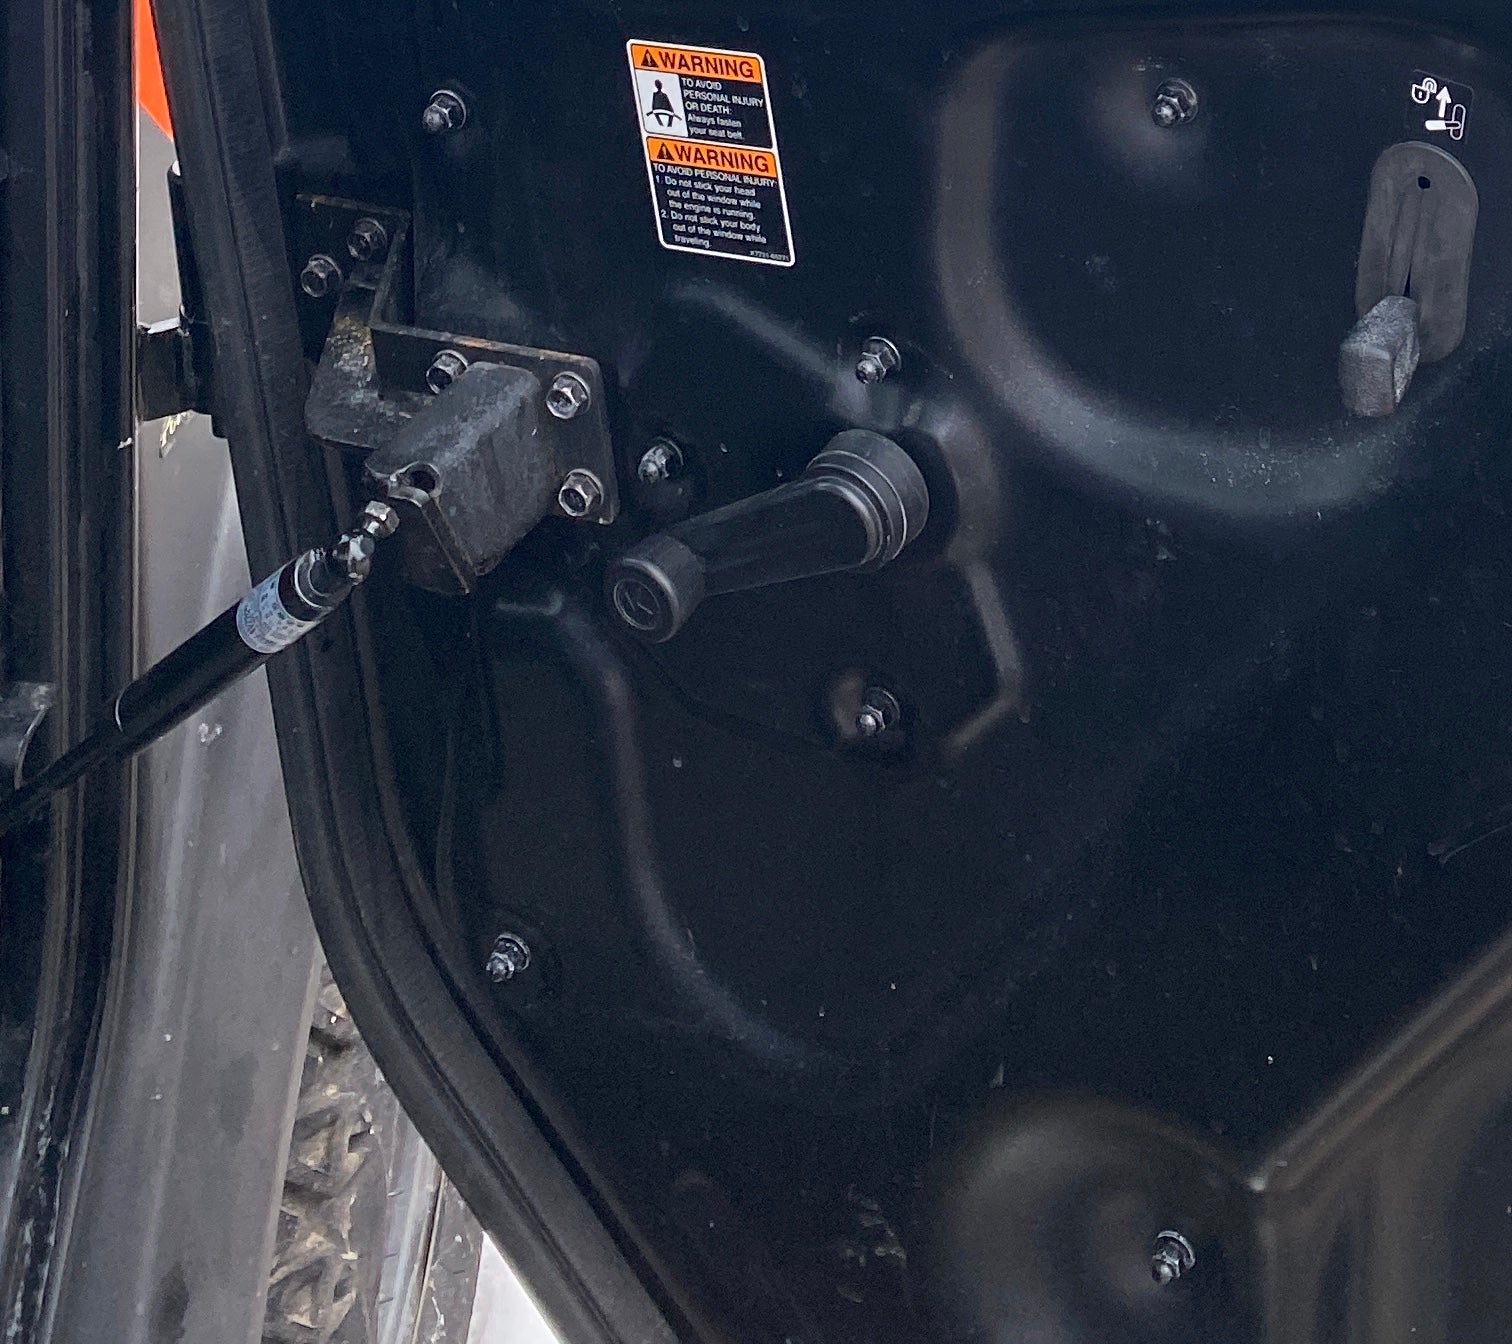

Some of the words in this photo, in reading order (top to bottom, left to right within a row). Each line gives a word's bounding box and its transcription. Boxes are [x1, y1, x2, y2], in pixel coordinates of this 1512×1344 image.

[658, 51, 754, 78] WARNING
[681, 78, 694, 87] TO
[696, 80, 722, 90] AVOID
[684, 90, 730, 103] PERSONAL
[732, 96, 763, 107] INJURY
[685, 101, 698, 111] OR
[701, 103, 732, 114] DEATH:
[688, 113, 716, 126] Always
[717, 116, 741, 127] fasten
[689, 126, 706, 136] your
[674, 144, 769, 172] WARNING
[653, 163, 666, 172] TO
[667, 166, 692, 177] AVOID
[694, 169, 742, 183] PERSONAL
[665, 176, 677, 185] Do
[679, 178, 692, 188] not
[694, 180, 713, 190] stick
[714, 184, 732, 193] your
[734, 186, 755, 196] head
[667, 189, 680, 198] out
[682, 190, 690, 198] of
[692, 191, 705, 201] the
[707, 194, 738, 206] window
[739, 198, 761, 208] while
[669, 200, 682, 209] the
[684, 203, 711, 213] engine
[713, 206, 721, 214] is
[722, 208, 756, 221] running.
[671, 211, 683, 220] Do
[685, 213, 698, 222] not
[699, 215, 718, 225] stick
[720, 218, 738, 228] your
[740, 220, 760, 233] body
[673, 224, 686, 232] out
[688, 225, 696, 233] of
[698, 226, 711, 236] the
[712, 229, 743, 240] window
[745, 233, 766, 244] while
